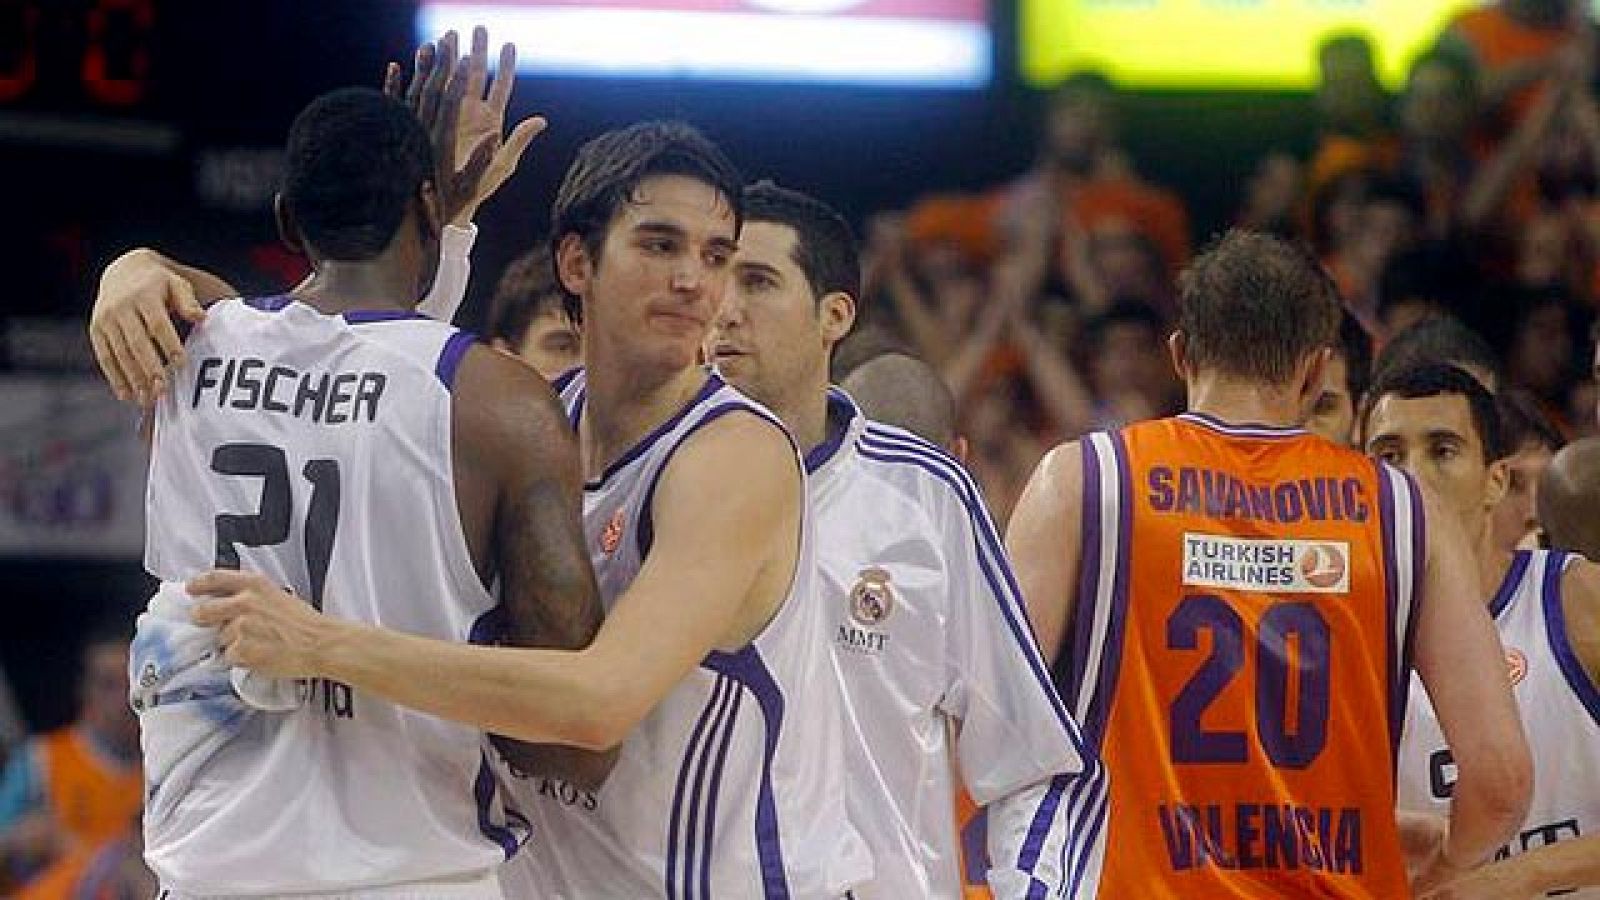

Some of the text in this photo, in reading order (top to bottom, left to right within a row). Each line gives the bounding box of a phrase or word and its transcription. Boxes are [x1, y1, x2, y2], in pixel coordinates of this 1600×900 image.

[192, 357, 386, 424] FISCHER
[1148, 466, 1369, 524] SAVANOVIC
[210, 444, 341, 613] 21
[1187, 539, 1294, 564] TURKISH
[1187, 561, 1294, 585] AIRLINES
[837, 626, 891, 650] MMT
[1166, 594, 1331, 770] 20
